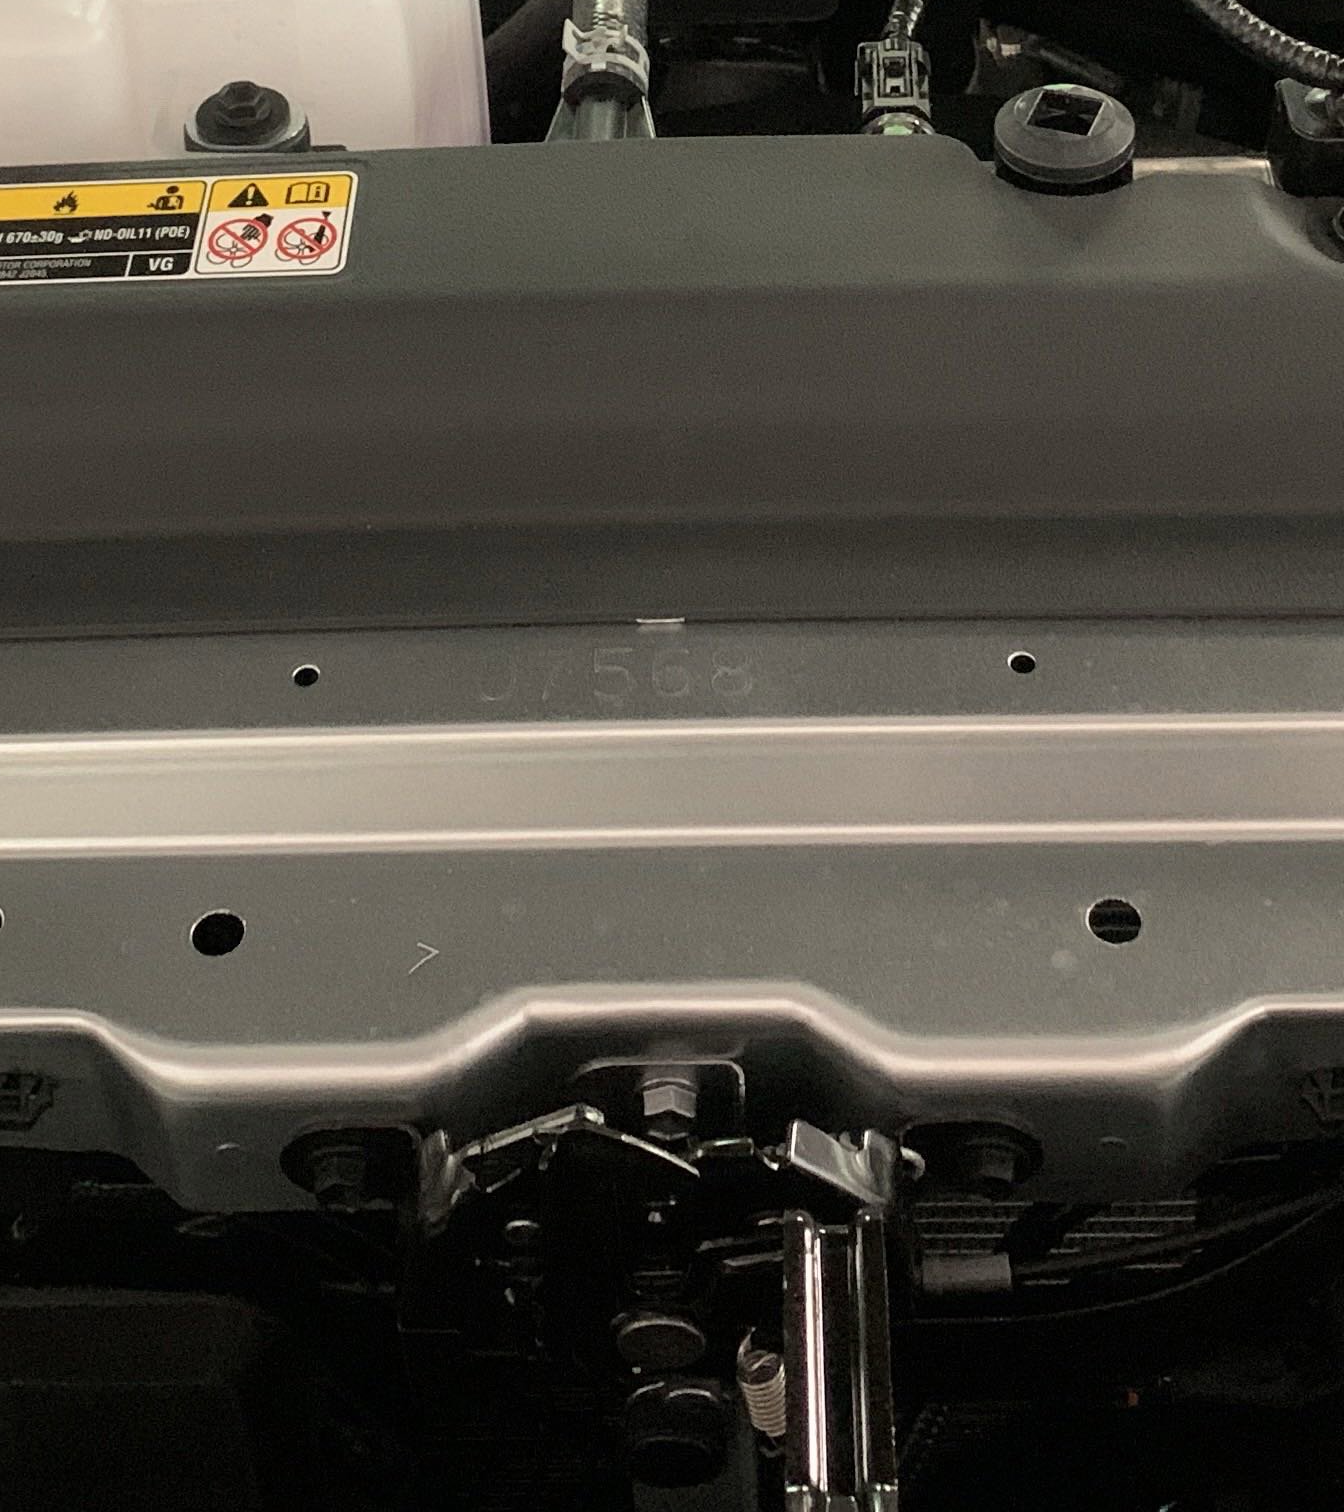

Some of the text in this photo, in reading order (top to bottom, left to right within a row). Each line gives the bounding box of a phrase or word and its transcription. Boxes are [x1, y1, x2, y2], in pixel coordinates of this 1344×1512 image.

[93, 227, 152, 241] ND-OIL11
[155, 226, 190, 240] (POE)
[23, 258, 92, 269] CORPORATION
[148, 257, 174, 271] VG
